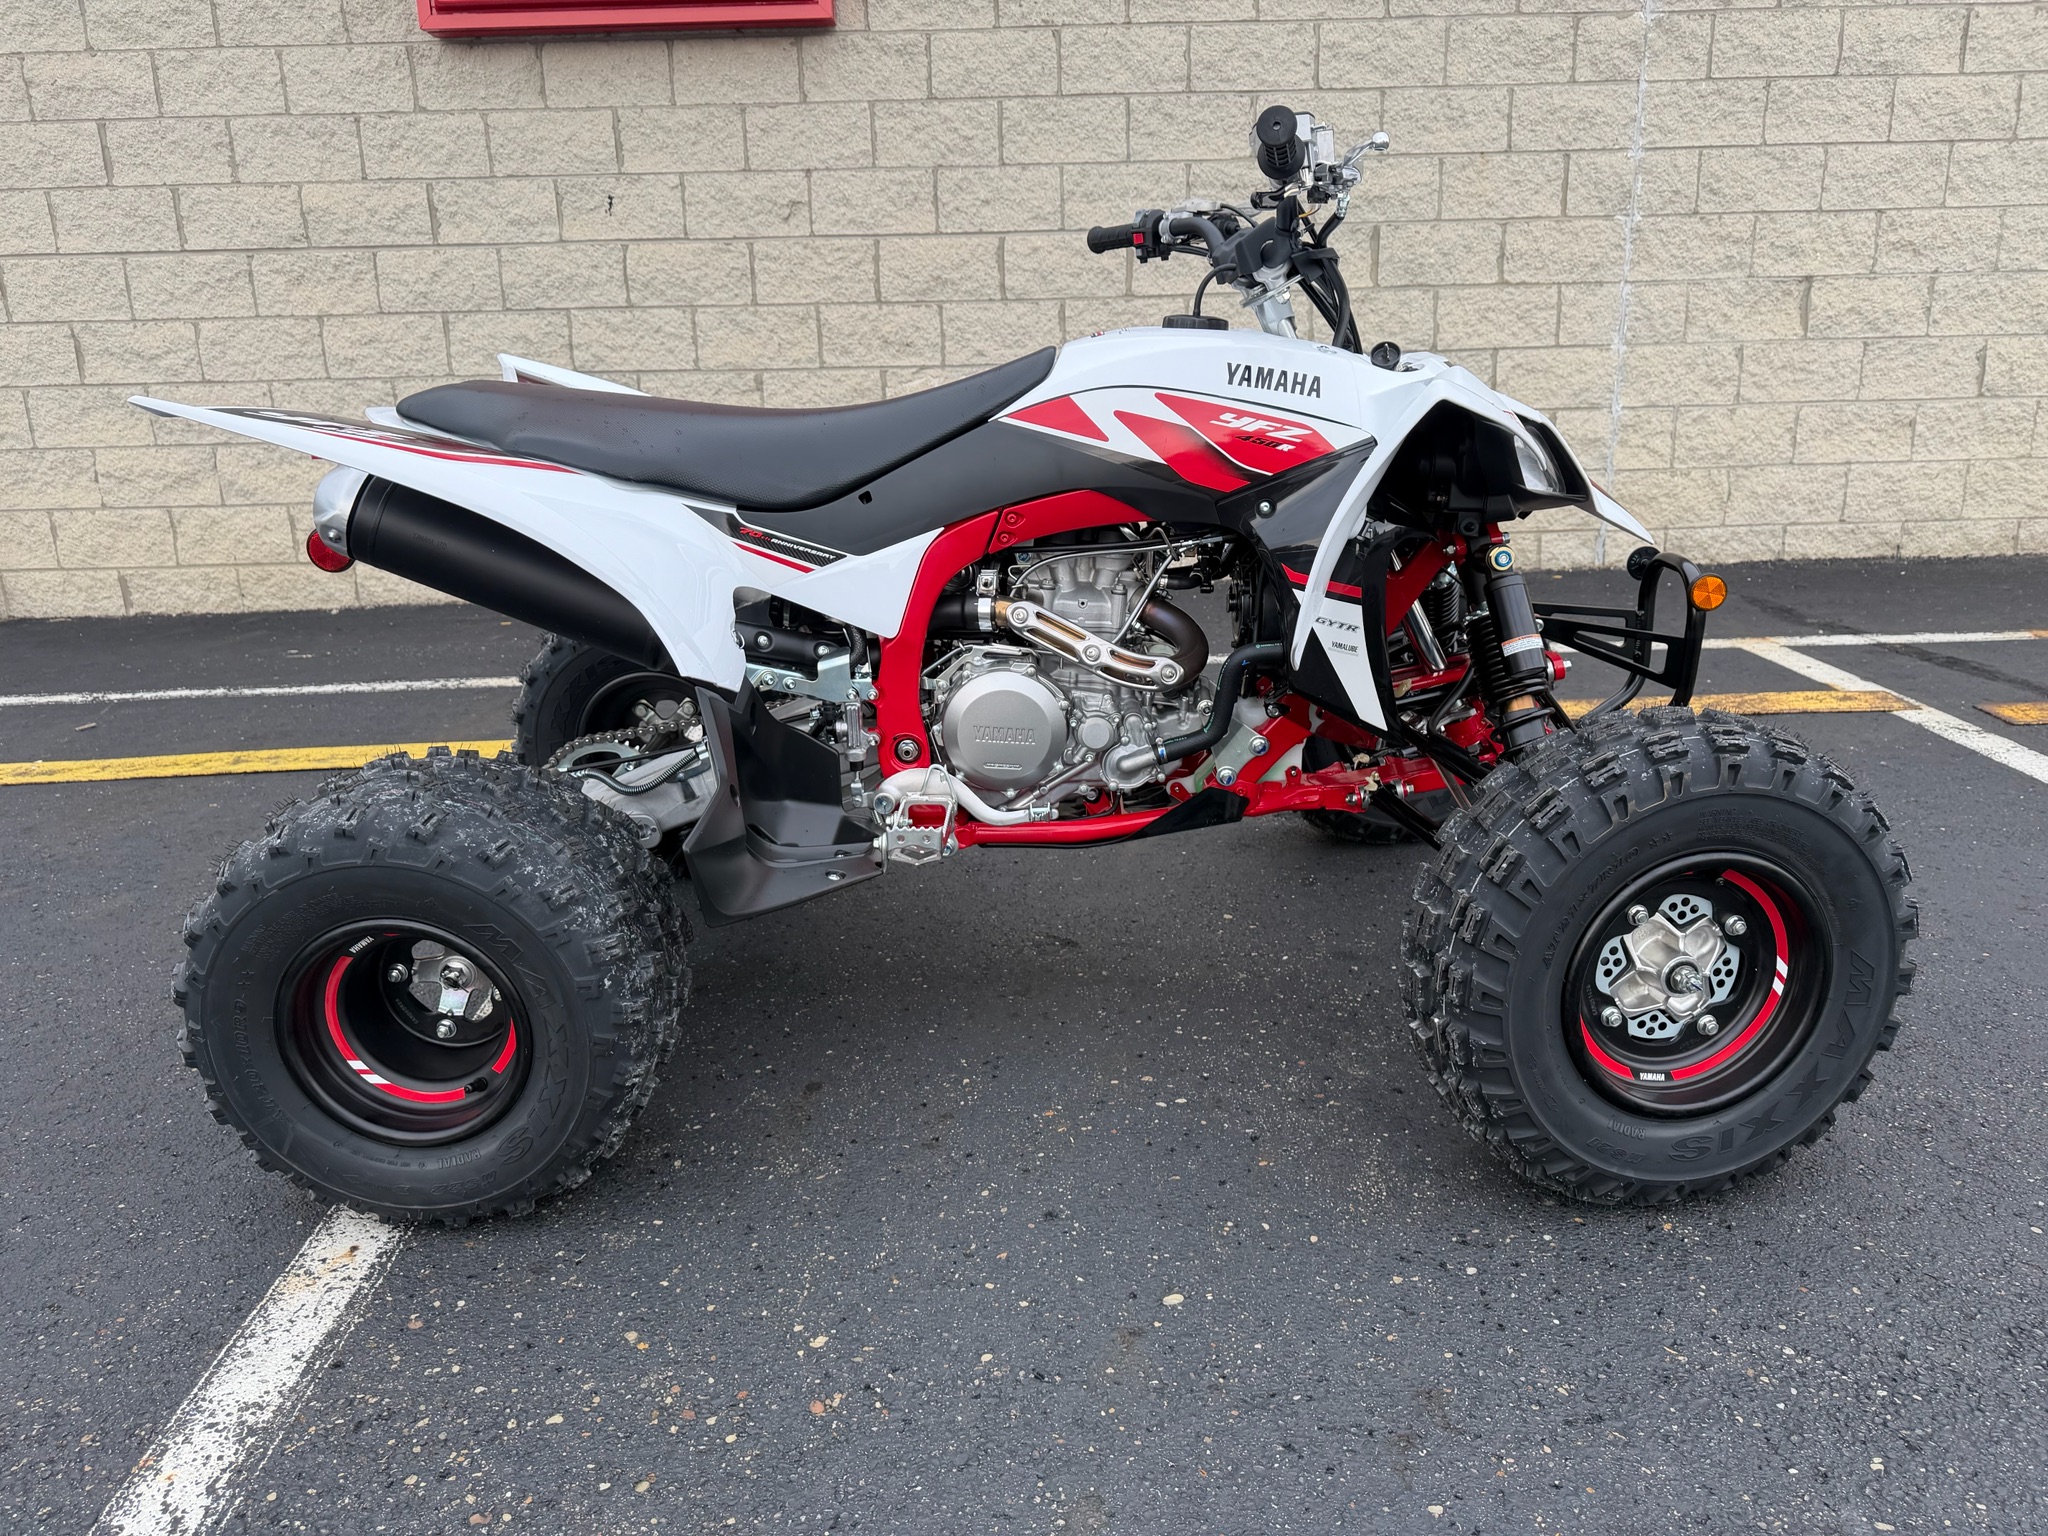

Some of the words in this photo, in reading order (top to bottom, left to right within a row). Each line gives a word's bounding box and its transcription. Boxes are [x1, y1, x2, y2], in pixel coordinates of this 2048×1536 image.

[1226, 361, 1321, 399] YAMAHA
[1209, 412, 1314, 443] YFZ
[1234, 435, 1297, 452] 450R
[770, 537, 837, 560] ANNIVERSARY
[1315, 616, 1361, 634] GYTR
[1331, 640, 1359, 654] YAMALUBE
[973, 725, 1036, 745] YAMAHA
[348, 935, 375, 955] YAMAHA
[463, 923, 569, 1165] MAXXIS
[1668, 948, 1876, 1162] MAXXIS
[1639, 1071, 1666, 1082] YAMAHA
[1607, 1117, 1646, 1140] RADIAL
[437, 1148, 481, 1169] RADIAL
[431, 1169, 497, 1195] MS22
